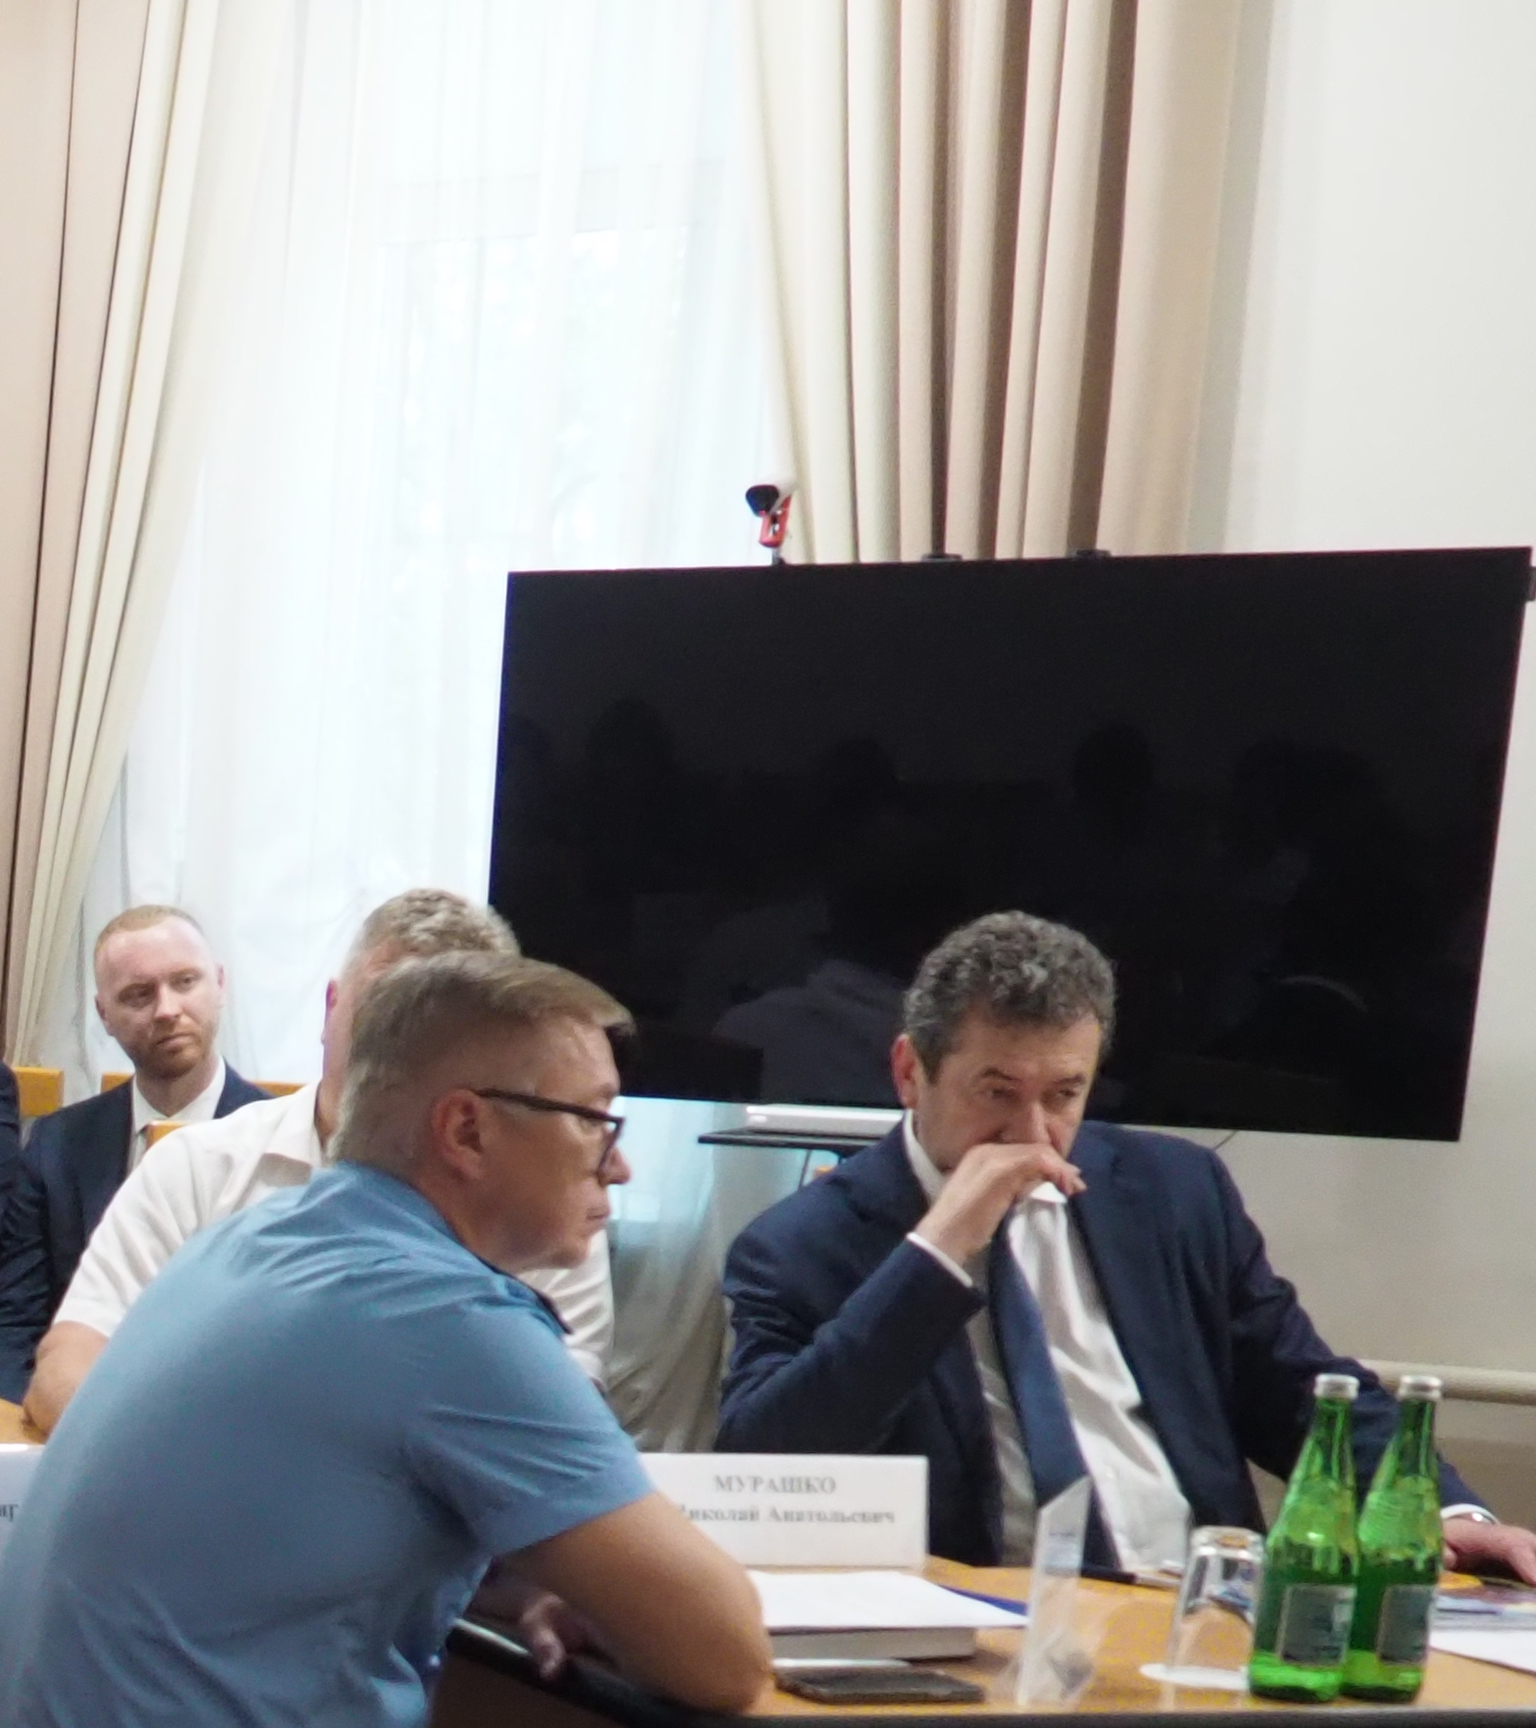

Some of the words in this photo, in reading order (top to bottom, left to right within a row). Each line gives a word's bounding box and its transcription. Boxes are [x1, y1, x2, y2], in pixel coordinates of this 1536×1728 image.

[713, 1475, 837, 1495] МУРАШКО
[678, 1504, 760, 1523] иколай
[767, 1506, 896, 1524] Анатольевич
